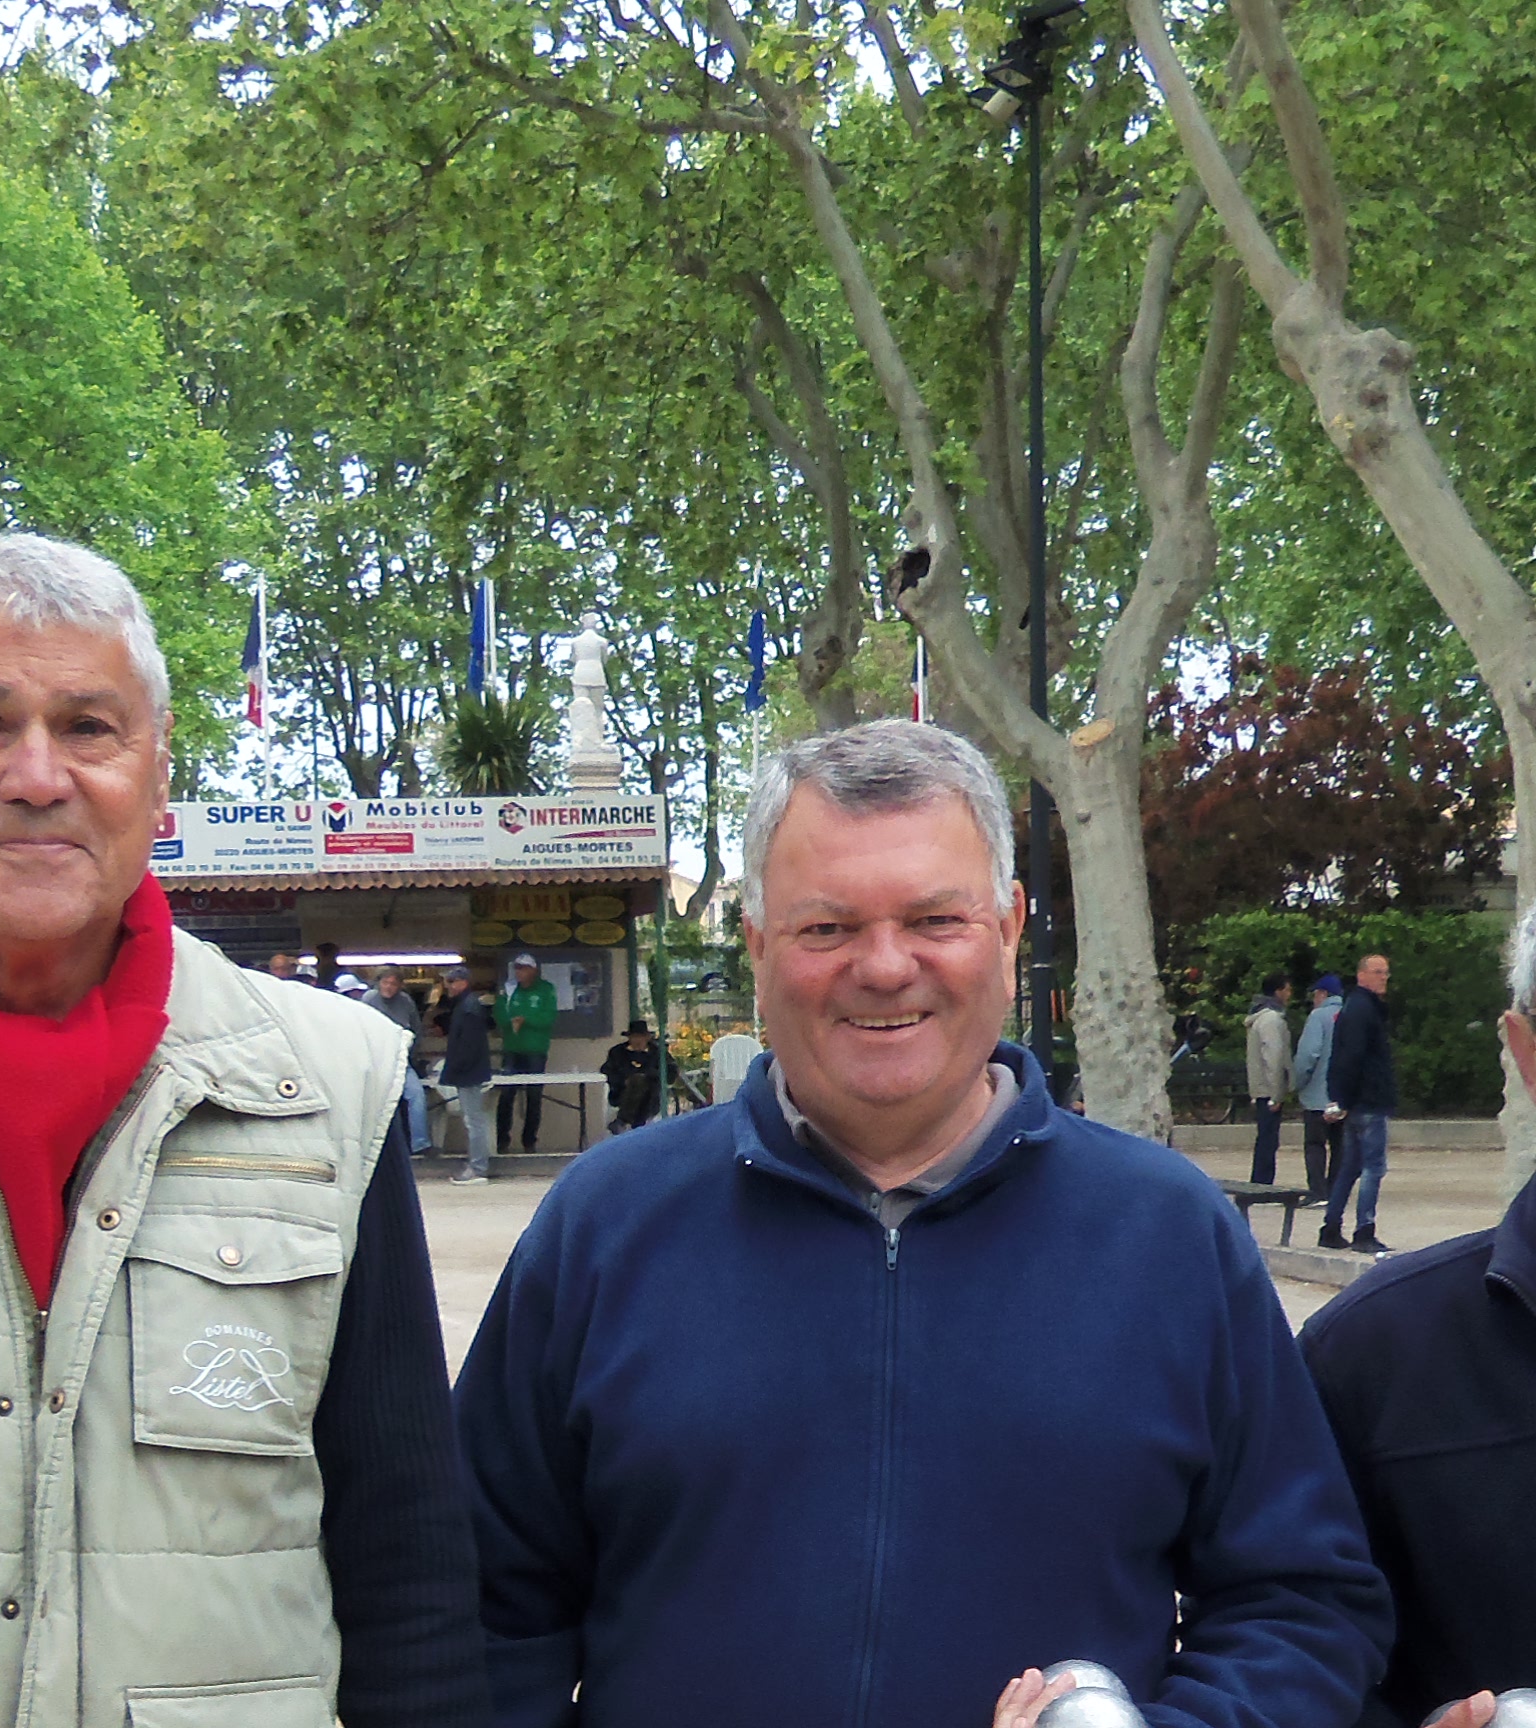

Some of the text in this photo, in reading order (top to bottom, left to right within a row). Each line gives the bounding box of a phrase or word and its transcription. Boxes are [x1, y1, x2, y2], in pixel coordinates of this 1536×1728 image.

[207, 805, 312, 824] SUPER U
[366, 801, 483, 817] Mobiclub
[530, 805, 657, 826] INTERMARCHE
[366, 820, 485, 830] Meubles du Littoral
[522, 841, 633, 854] AIGUES-MORTES
[205, 1325, 274, 1346] DOMAINES
[169, 1340, 295, 1411] Listel
